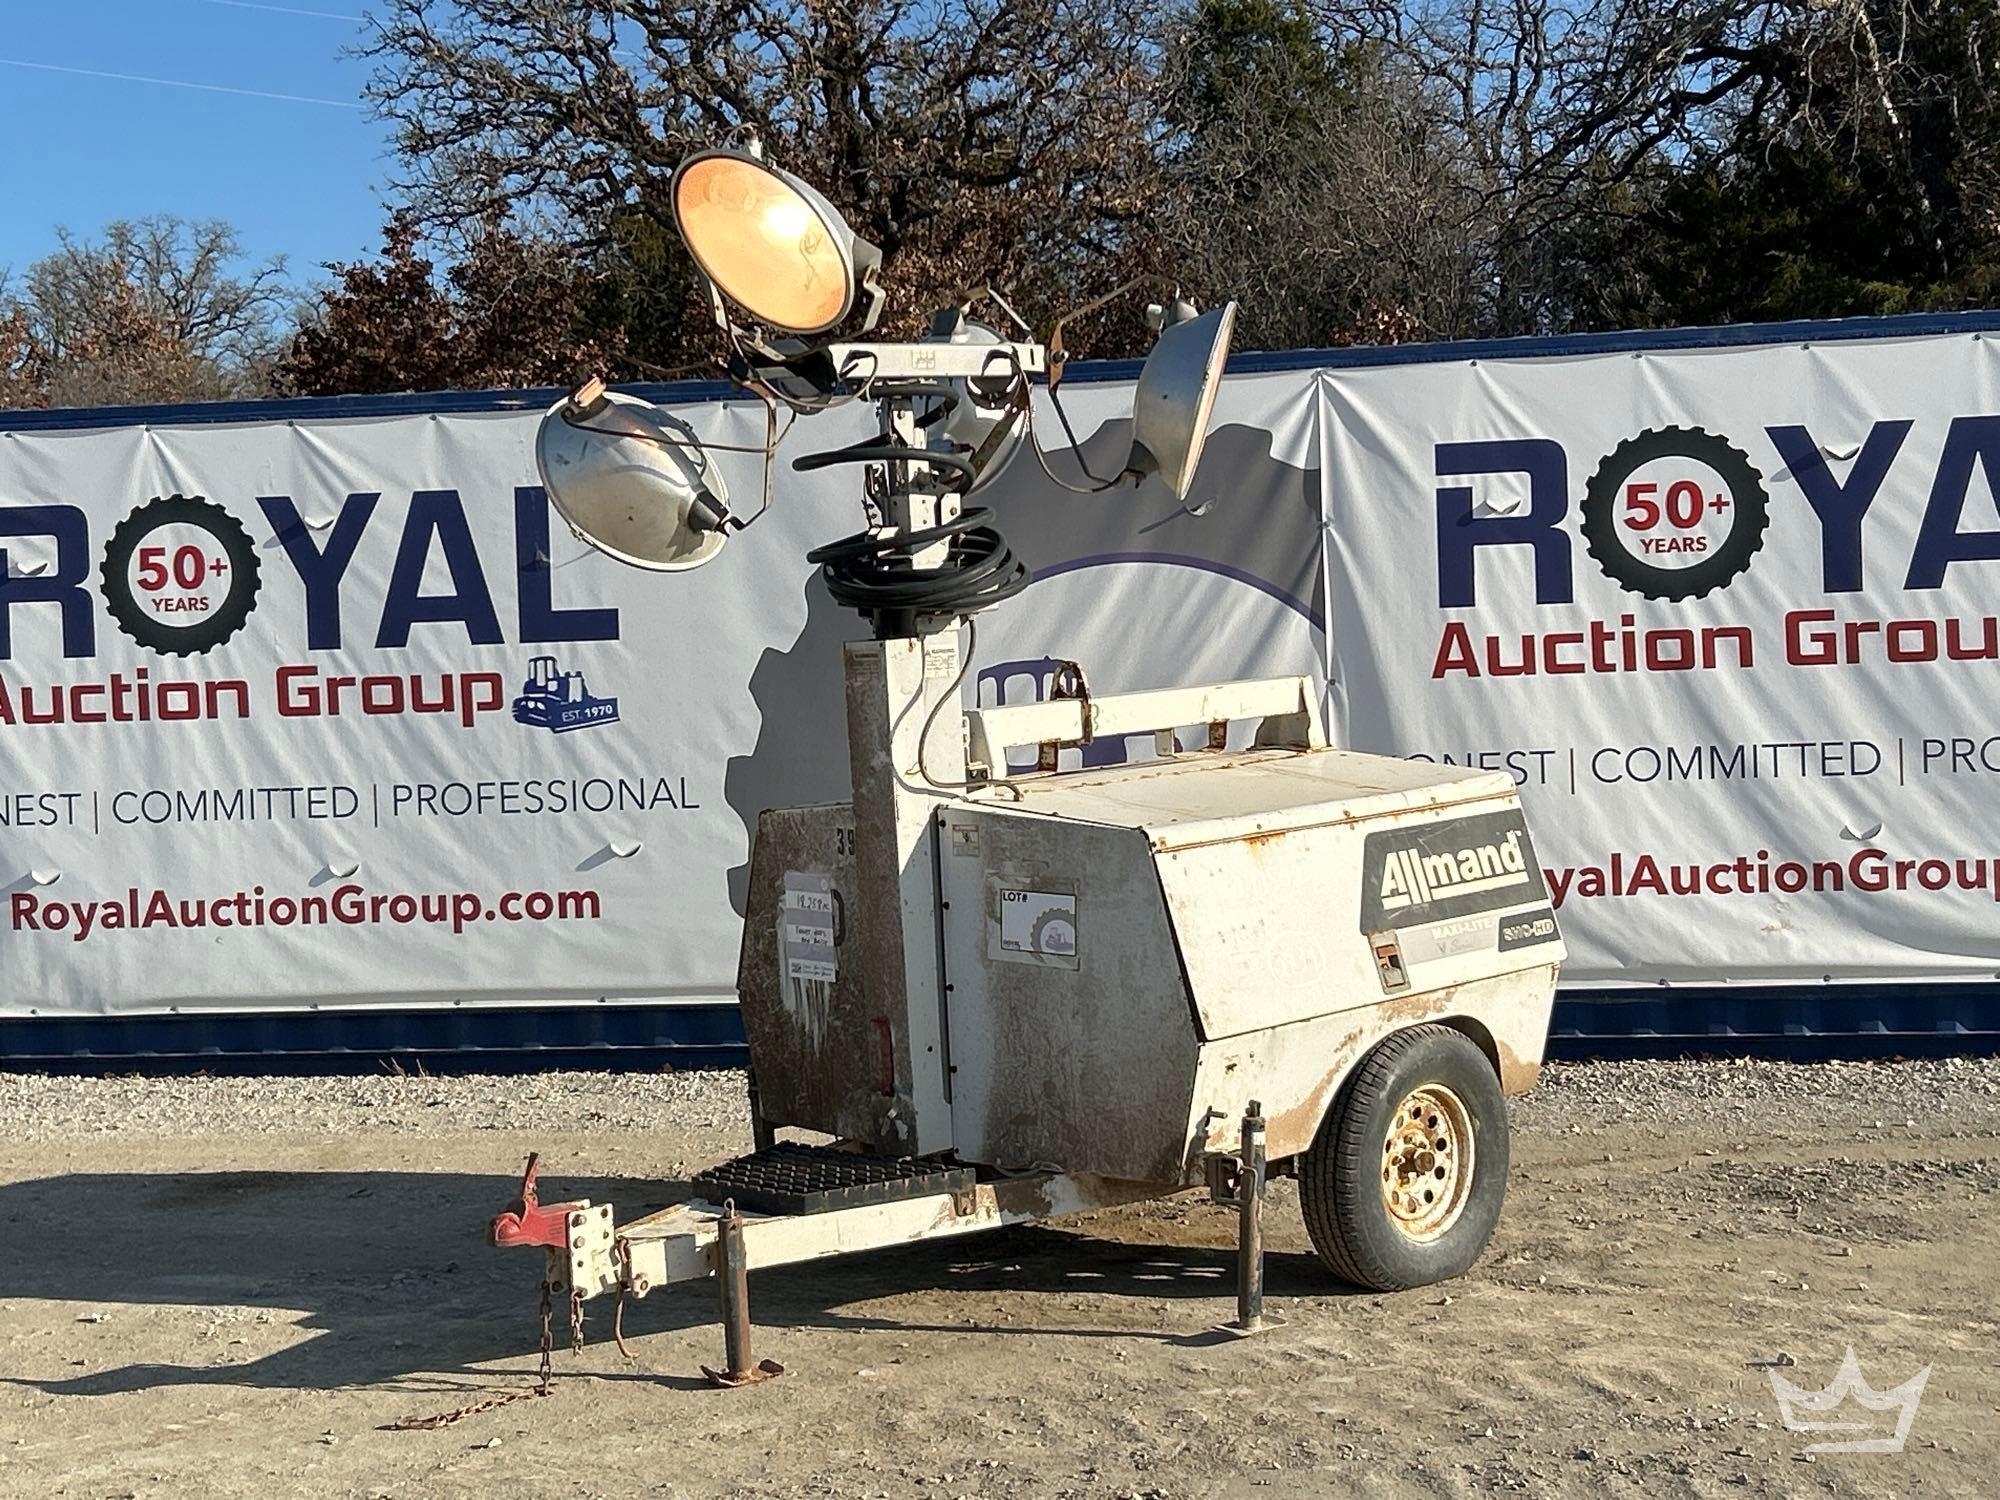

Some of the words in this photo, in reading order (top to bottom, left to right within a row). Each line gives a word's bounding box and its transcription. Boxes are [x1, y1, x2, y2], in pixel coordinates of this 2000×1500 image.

[1624, 479, 1731, 532] 50+
[136, 544, 229, 592] 50+
[1639, 535, 1709, 555] YEARS
[151, 595, 210, 614] YEARS
[1432, 613, 1754, 680] Auction
[275, 664, 503, 727] Group
[584, 704, 613, 718] 1970
[1590, 740, 1882, 786] COMMITTED
[111, 785, 360, 825] COMMITTED
[392, 775, 700, 818] PROFESSIONAL
[1380, 830, 1526, 910] Allmand
[11, 884, 601, 942] RoyalAuctionGroup.com
